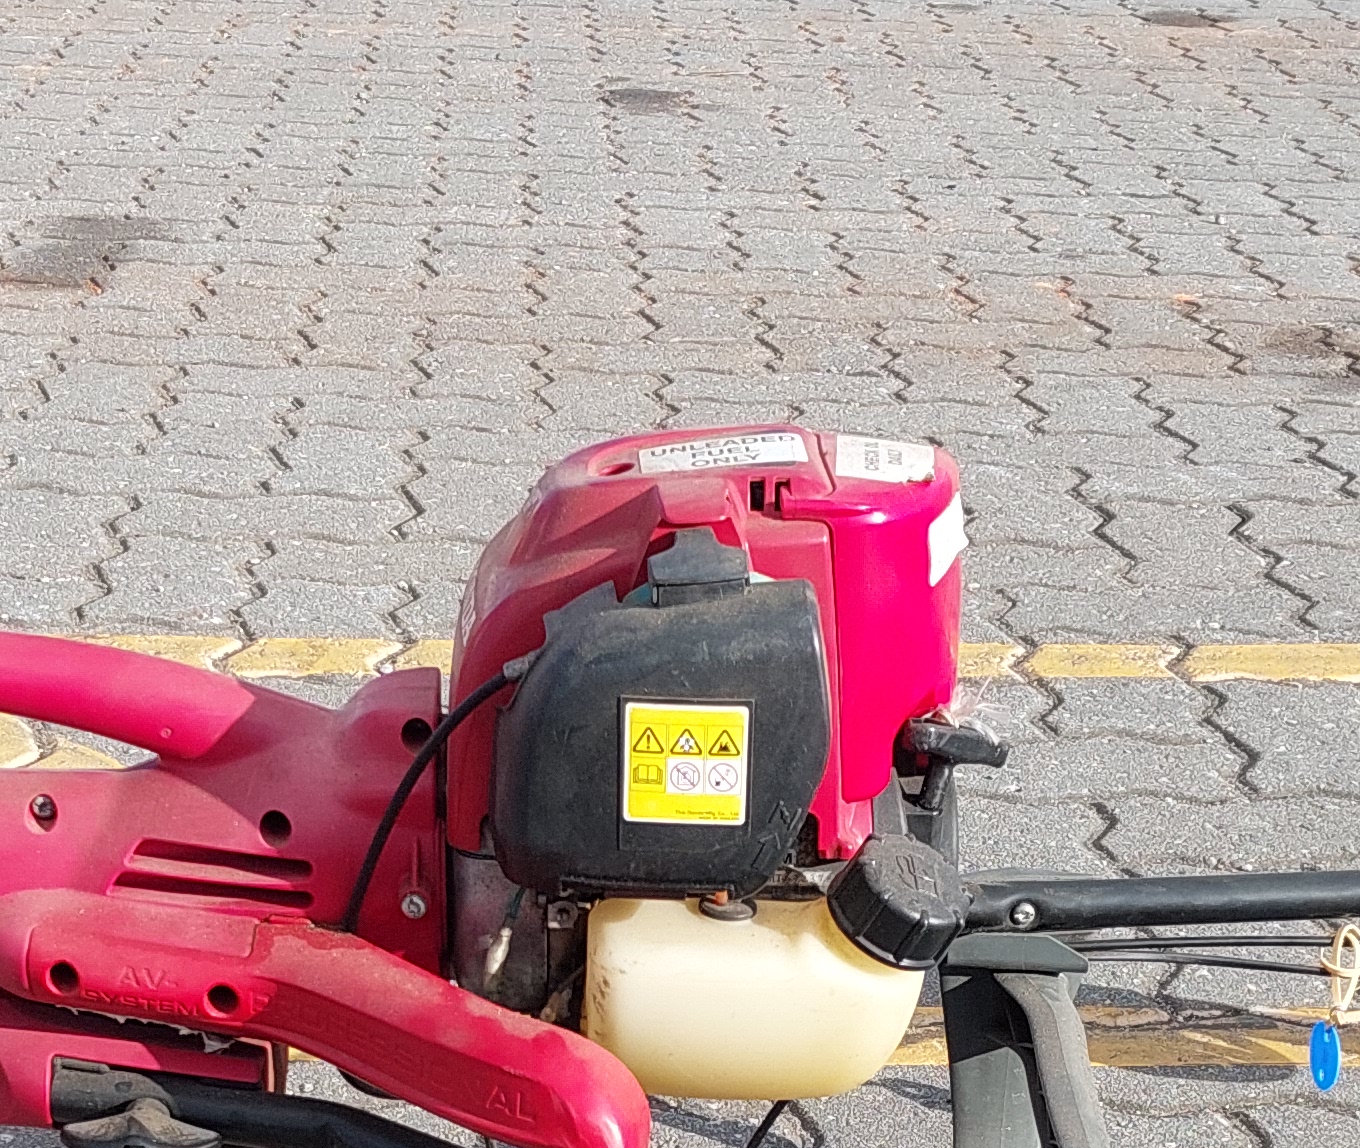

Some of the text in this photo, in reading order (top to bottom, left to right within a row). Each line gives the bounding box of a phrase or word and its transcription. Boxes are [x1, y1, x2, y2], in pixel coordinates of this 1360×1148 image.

[650, 434, 795, 457] UNLEADED
[691, 445, 760, 459] FUEL
[691, 453, 761, 467] ONLY
[82, 989, 199, 1017] SYSTEM
